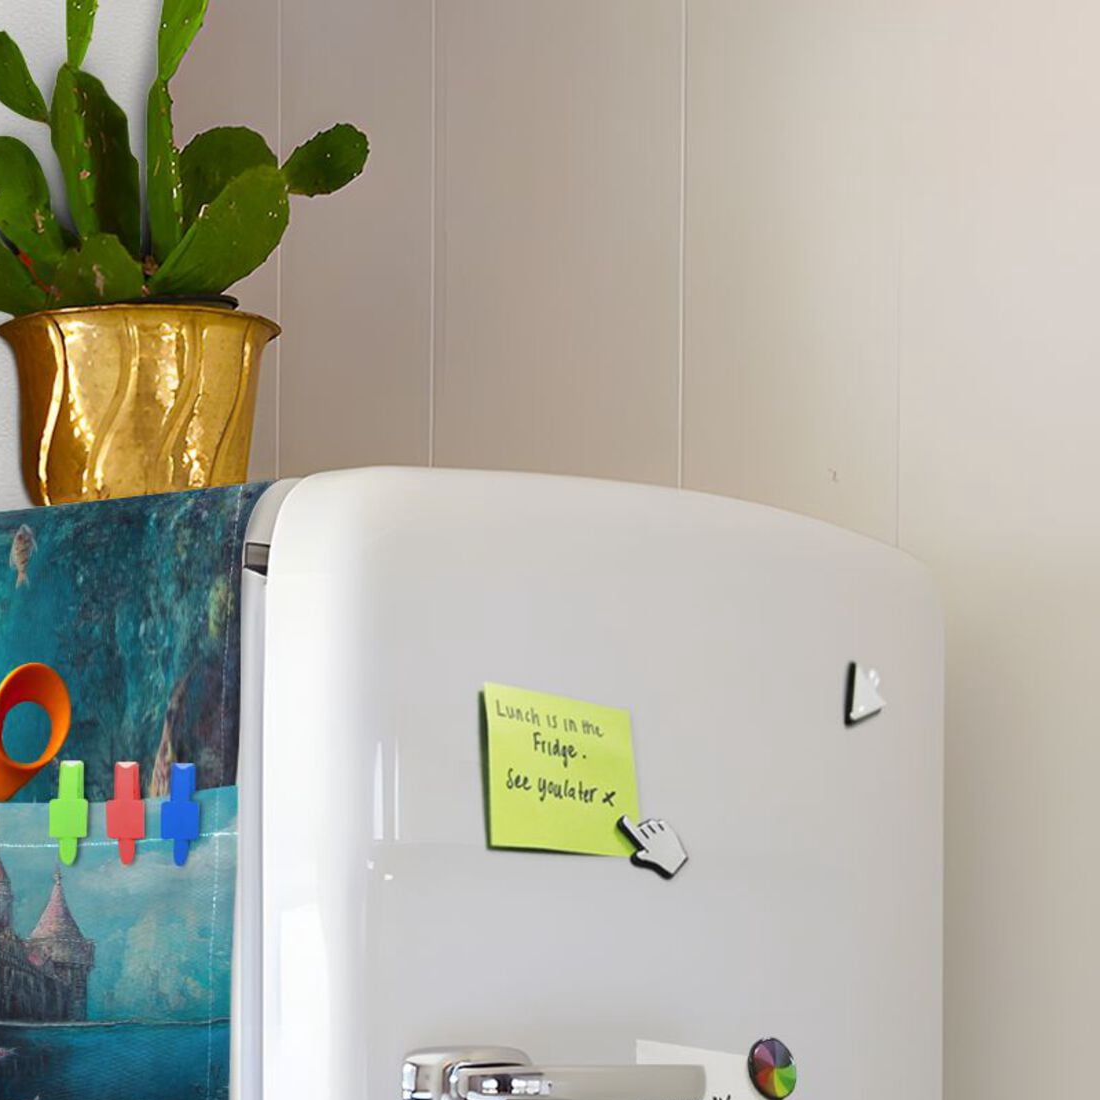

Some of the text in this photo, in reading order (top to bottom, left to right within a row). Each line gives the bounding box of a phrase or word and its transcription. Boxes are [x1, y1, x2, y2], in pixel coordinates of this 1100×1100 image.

[496, 700, 604, 738] Lunch is in the
[506, 768, 531, 791] See
